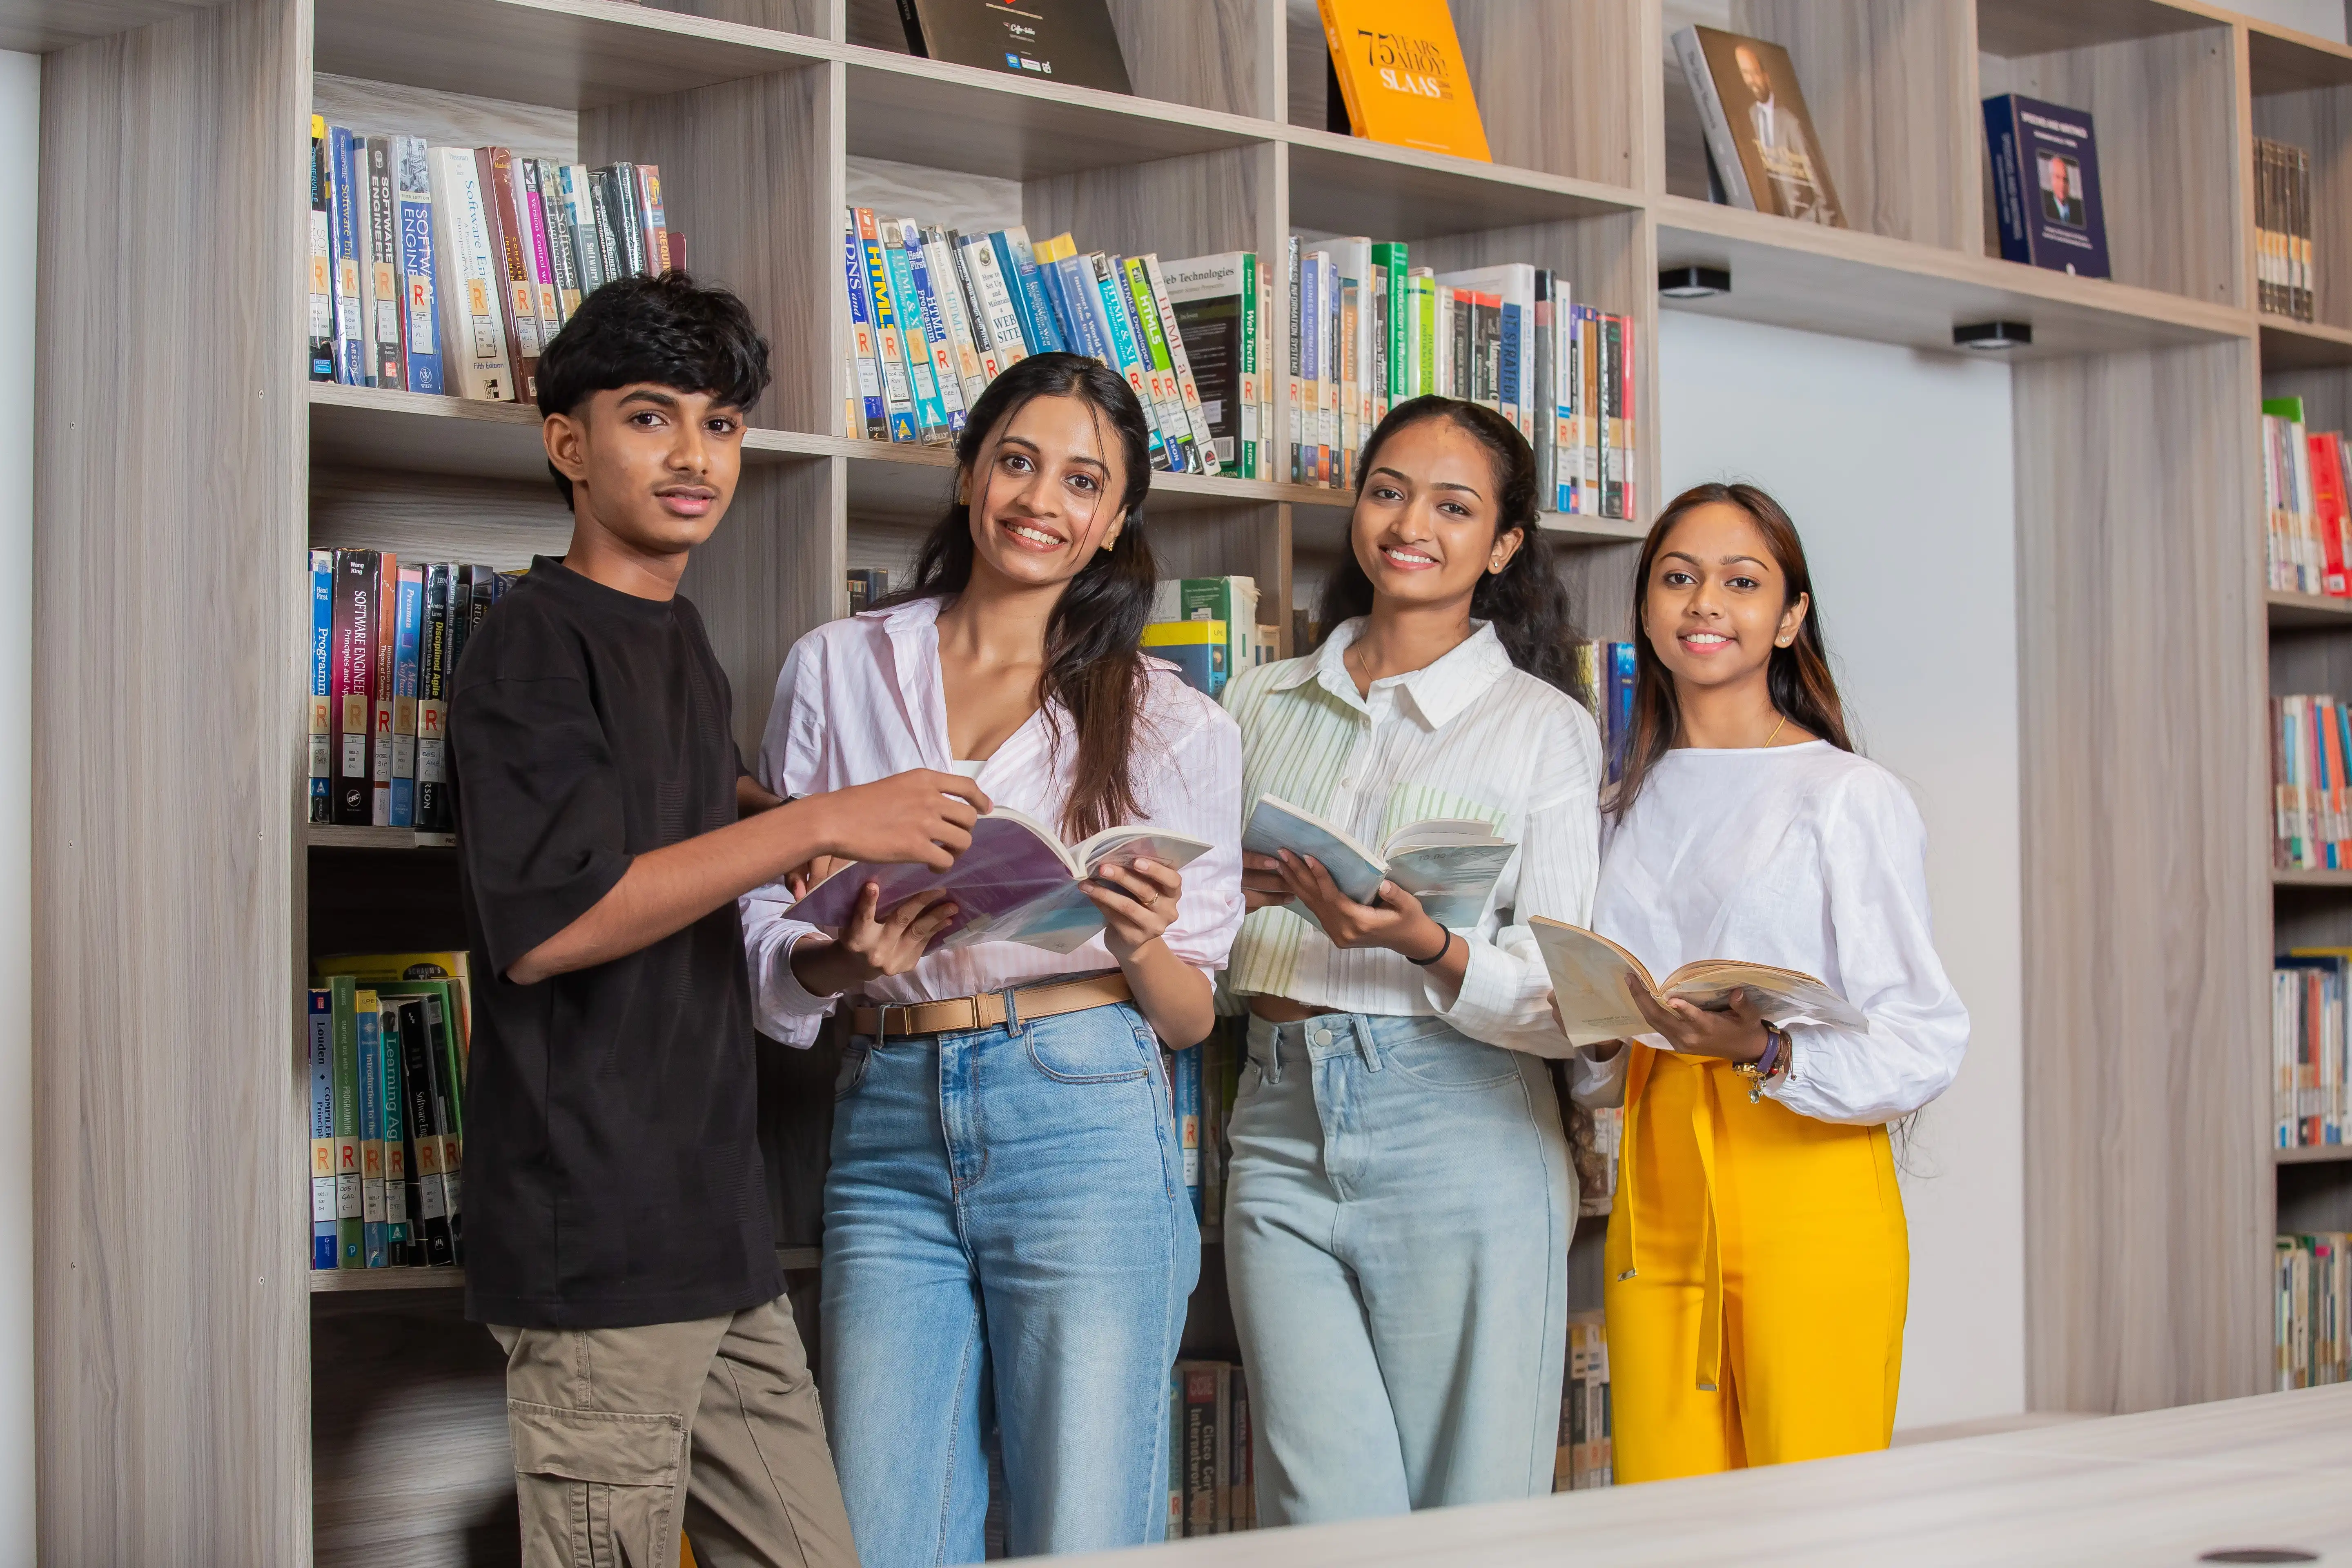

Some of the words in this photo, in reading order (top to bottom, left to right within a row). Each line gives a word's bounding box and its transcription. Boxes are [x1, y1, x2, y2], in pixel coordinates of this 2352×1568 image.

[1358, 28, 1394, 66] 75
[1380, 67, 1440, 98] SLAAS
[342, 184, 351, 236] Software
[381, 176, 392, 263] SOFTWARE
[465, 180, 481, 248] Software
[530, 198, 540, 231] Version
[536, 233, 546, 268] Control
[504, 237, 515, 281] IMPLEMEN
[512, 237, 522, 280] COMPILER
[548, 213, 565, 287] Engineering
[558, 212, 575, 288] Software
[907, 250, 923, 260] Head
[587, 243, 598, 283] Software
[846, 244, 862, 290] DNS
[909, 260, 926, 271] First
[315, 265, 324, 287] R
[346, 269, 356, 290] R
[380, 272, 390, 293] R
[897, 255, 912, 298] HTML
[1164, 275, 1176, 284] eb
[1179, 267, 1234, 282] Technologies
[414, 285, 424, 305] R
[473, 288, 484, 308] R
[517, 290, 529, 310] R
[543, 293, 554, 313] R
[851, 293, 861, 316] and
[988, 298, 1010, 308] Maintain
[1107, 285, 1124, 326] HTML
[993, 314, 1016, 330] WEB
[1140, 295, 1161, 344] HTML5
[1158, 297, 1182, 356] HTML
[859, 333, 869, 352] R
[997, 327, 1021, 343] SITE
[1089, 320, 1102, 347] World
[1397, 331, 1404, 340] to
[886, 337, 897, 356] R
[937, 350, 949, 369] R
[986, 359, 998, 378] R
[1503, 332, 1517, 403] STRATEGY
[1130, 373, 1142, 391] R
[1152, 379, 1163, 396] R
[1164, 378, 1176, 396] R
[1185, 384, 1196, 402] R
[1245, 381, 1253, 400] R
[1291, 384, 1297, 402] R
[355, 591, 366, 645] SOFTWARE
[405, 588, 415, 628] Pressman
[342, 629, 351, 664] Principles
[433, 622, 444, 671] Disciplined
[317, 628, 328, 695] Programm
[432, 673, 441, 696] Agile
[317, 705, 327, 727] R
[350, 705, 362, 726] R
[379, 710, 390, 733] R
[426, 710, 437, 731] R
[348, 794, 359, 803] CRC
[408, 967, 441, 975] SCHAUM'S
[316, 1022, 325, 1065] Louden
[366, 1054, 374, 1107] Introduction
[386, 1038, 399, 1111] Learning
[343, 1086, 352, 1135] PROGRAMMING
[368, 1111, 374, 1119] to
[416, 1091, 426, 1123] Software
[1187, 1124, 1196, 1142] R
[317, 1148, 329, 1169] R
[343, 1146, 354, 1168] R
[367, 1149, 379, 1171] R
[392, 1151, 403, 1173] R
[423, 1146, 434, 1168] R
[446, 1143, 458, 1165] R
[1203, 1425, 1214, 1460] Cisco
[1172, 1497, 1180, 1515] R
